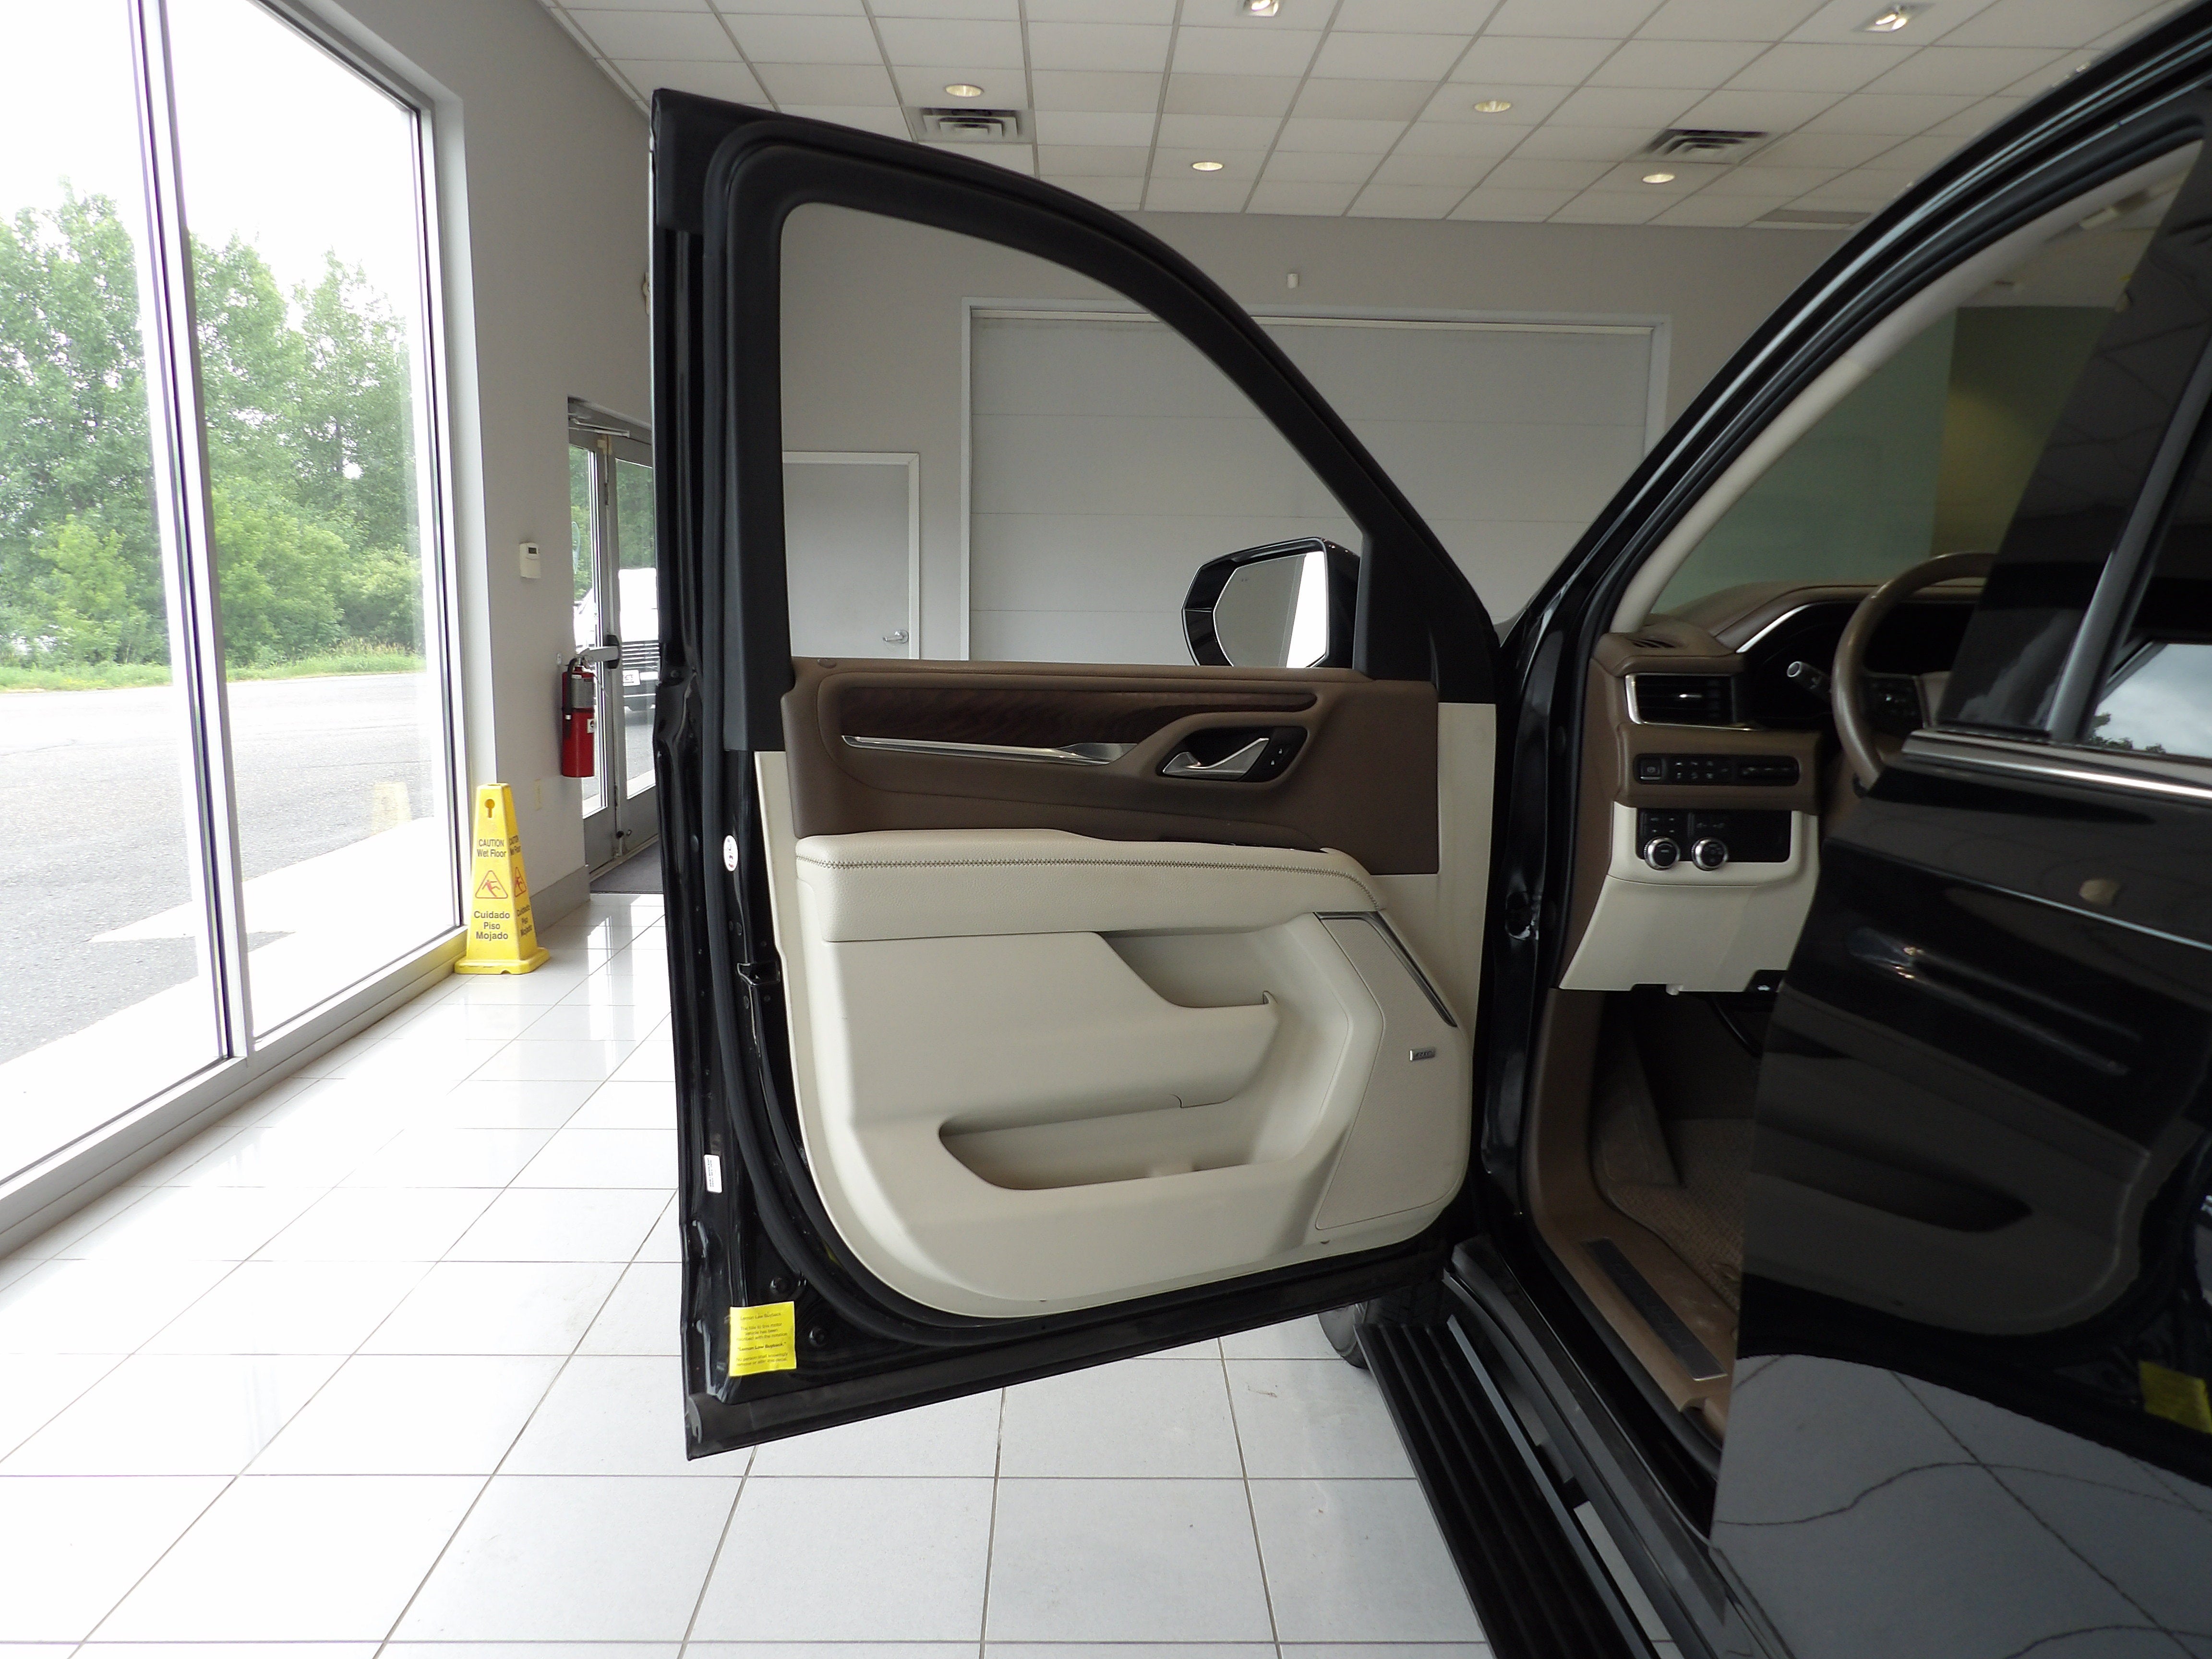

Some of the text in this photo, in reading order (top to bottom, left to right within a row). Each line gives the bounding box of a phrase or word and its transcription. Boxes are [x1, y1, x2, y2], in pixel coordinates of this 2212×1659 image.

[477, 849, 506, 857] Wet Floor
[474, 911, 510, 919] Cuidado
[476, 932, 508, 941] Mojado
